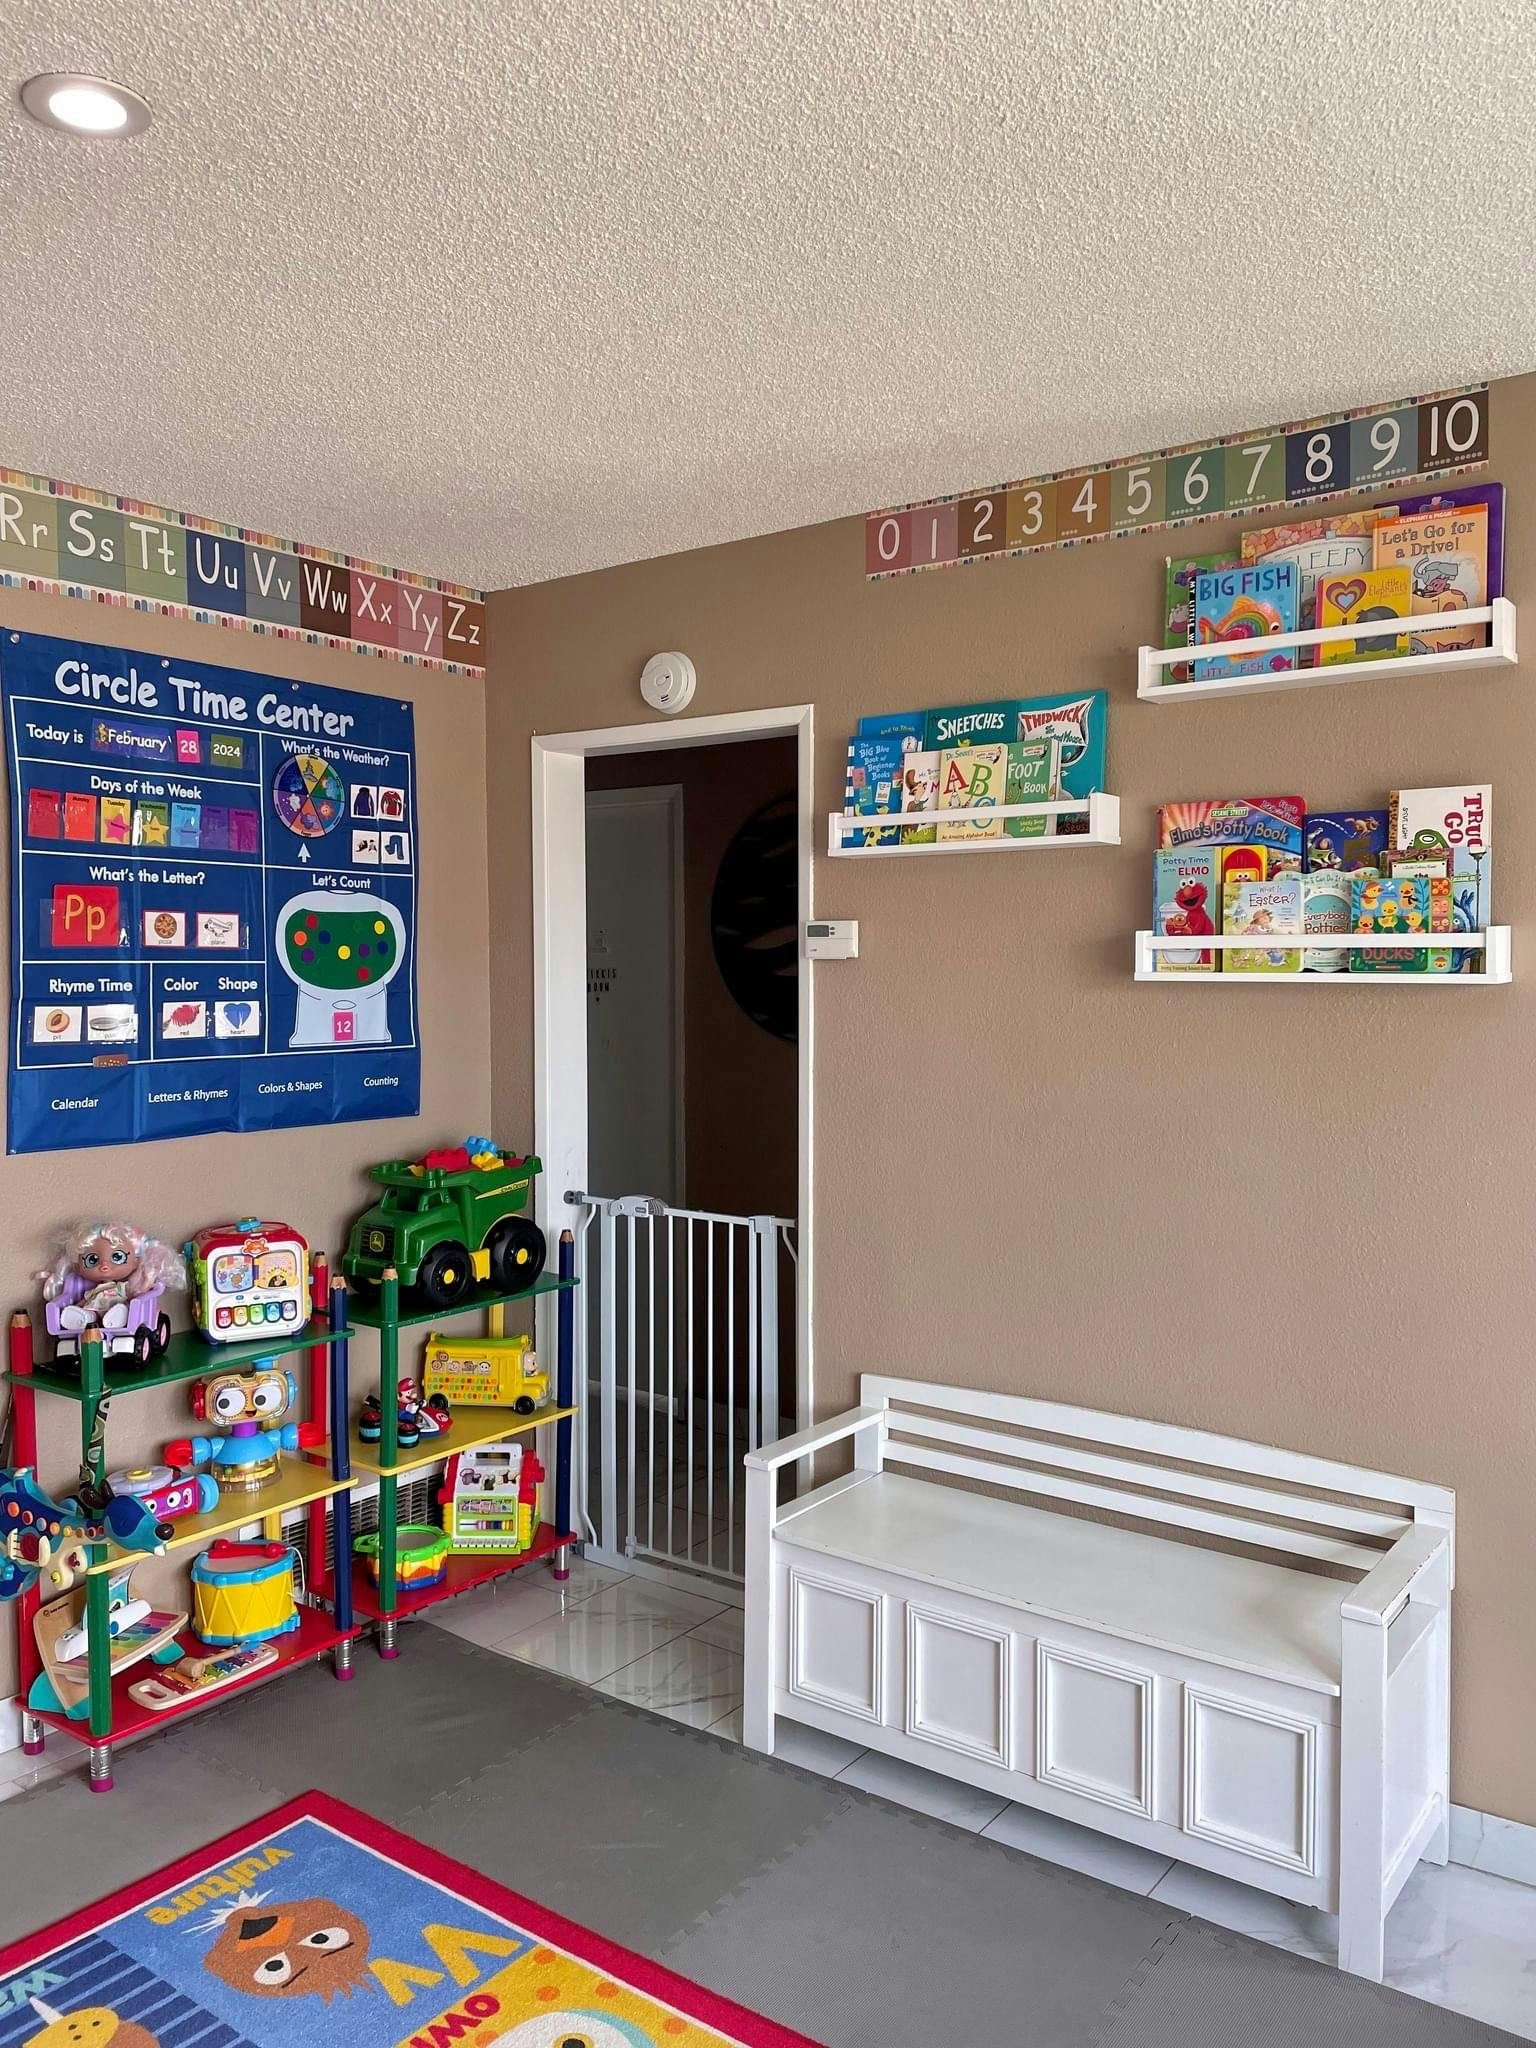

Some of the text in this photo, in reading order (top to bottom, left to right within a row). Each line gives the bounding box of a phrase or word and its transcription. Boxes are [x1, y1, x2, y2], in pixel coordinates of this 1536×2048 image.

[878, 400, 1480, 560] 0 1 2 3 4 5 6 7 8 9 10
[1381, 522, 1475, 545] Let's Go for
[1396, 537, 1459, 558] a Drive!
[1291, 547, 1372, 570] LEEPY
[1200, 566, 1290, 601] BIG FISH
[1240, 662, 1264, 673] FISH
[54, 660, 354, 737] Circle Time Center
[937, 712, 1005, 741] SNEETCHES
[1020, 703, 1087, 733] THIDWICK
[26, 723, 167, 753] Today is February
[180, 740, 198, 754] 28
[213, 743, 241, 758] 2024
[281, 740, 320, 756] What's
[323, 746, 340, 759] the
[342, 749, 389, 767] Weather?
[864, 756, 879, 765] Book
[871, 772, 890, 780] Books
[1008, 761, 1045, 780] FOOT
[90, 776, 202, 800] Days of the Week
[1023, 782, 1047, 794] BOOK
[1169, 821, 1289, 845] Elmo's Potty Book
[1444, 812, 1464, 844] GO
[1163, 858, 1187, 867] Potty
[1178, 866, 1209, 876] ELMO
[89, 866, 206, 885] What's the Letter?
[312, 874, 371, 889] Let's Count
[49, 978, 133, 996] Rhyme Time
[163, 978, 199, 991] Color
[218, 976, 258, 992] Shape
[230, 1028, 246, 1036] heart
[335, 1020, 352, 1033] 12
[258, 1080, 323, 1094] Colors & Shapes
[363, 1076, 399, 1088] Counting
[51, 1097, 99, 1110] Calendar
[148, 1088, 228, 1103] Letters & Rhymes
[144, 1847, 295, 1925] vulture
